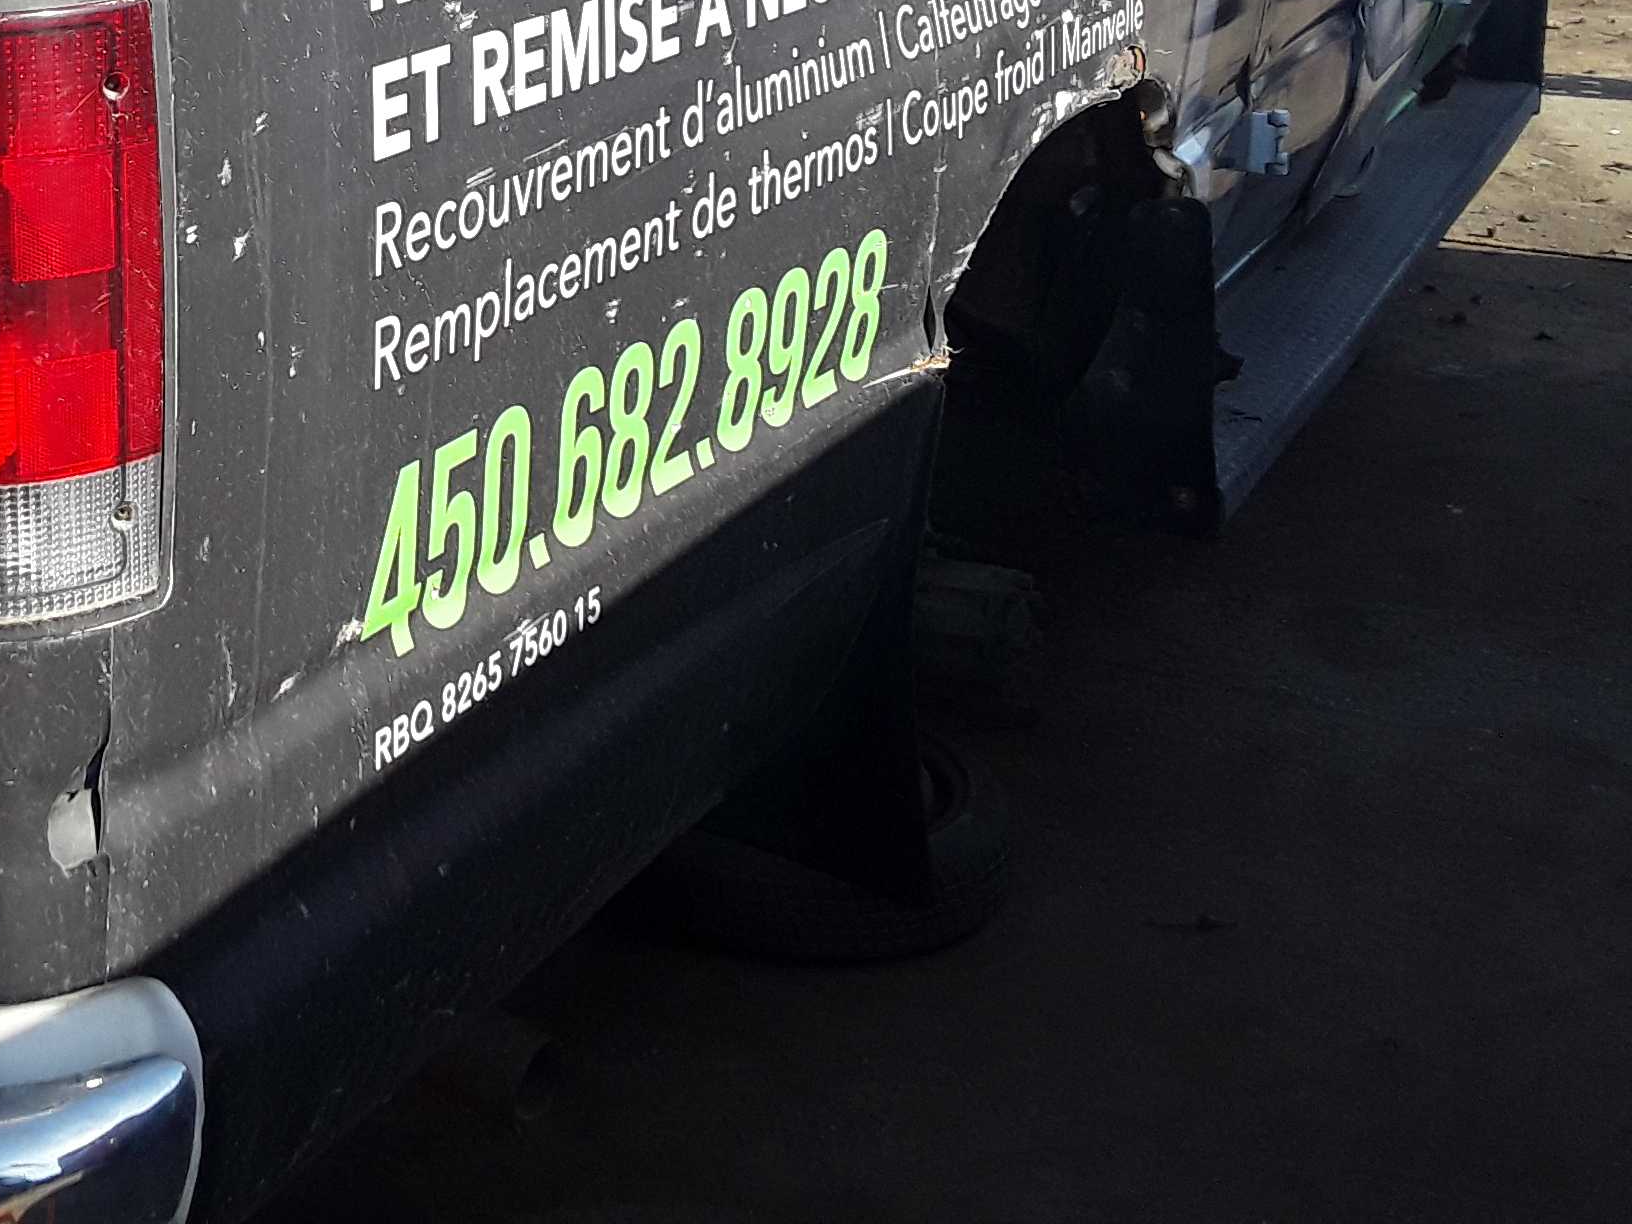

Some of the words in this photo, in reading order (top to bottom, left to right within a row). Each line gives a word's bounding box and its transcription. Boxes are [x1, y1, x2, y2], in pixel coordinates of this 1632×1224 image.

[372, 43, 452, 163] ET
[373, 200, 683, 392] Remplacement
[691, 171, 738, 240] de
[748, 125, 879, 217] thermos
[902, 80, 989, 140] Coupe
[995, 31, 1046, 105] froid
[374, 105, 671, 277] Recouvrement
[681, 34, 875, 149] d'aluminium
[359, 227, 888, 658] 450.682.8928
[373, 700, 434, 772] RBQ
[441, 648, 503, 730] 8265
[509, 609, 568, 678] 7560
[574, 586, 602, 634] 15
